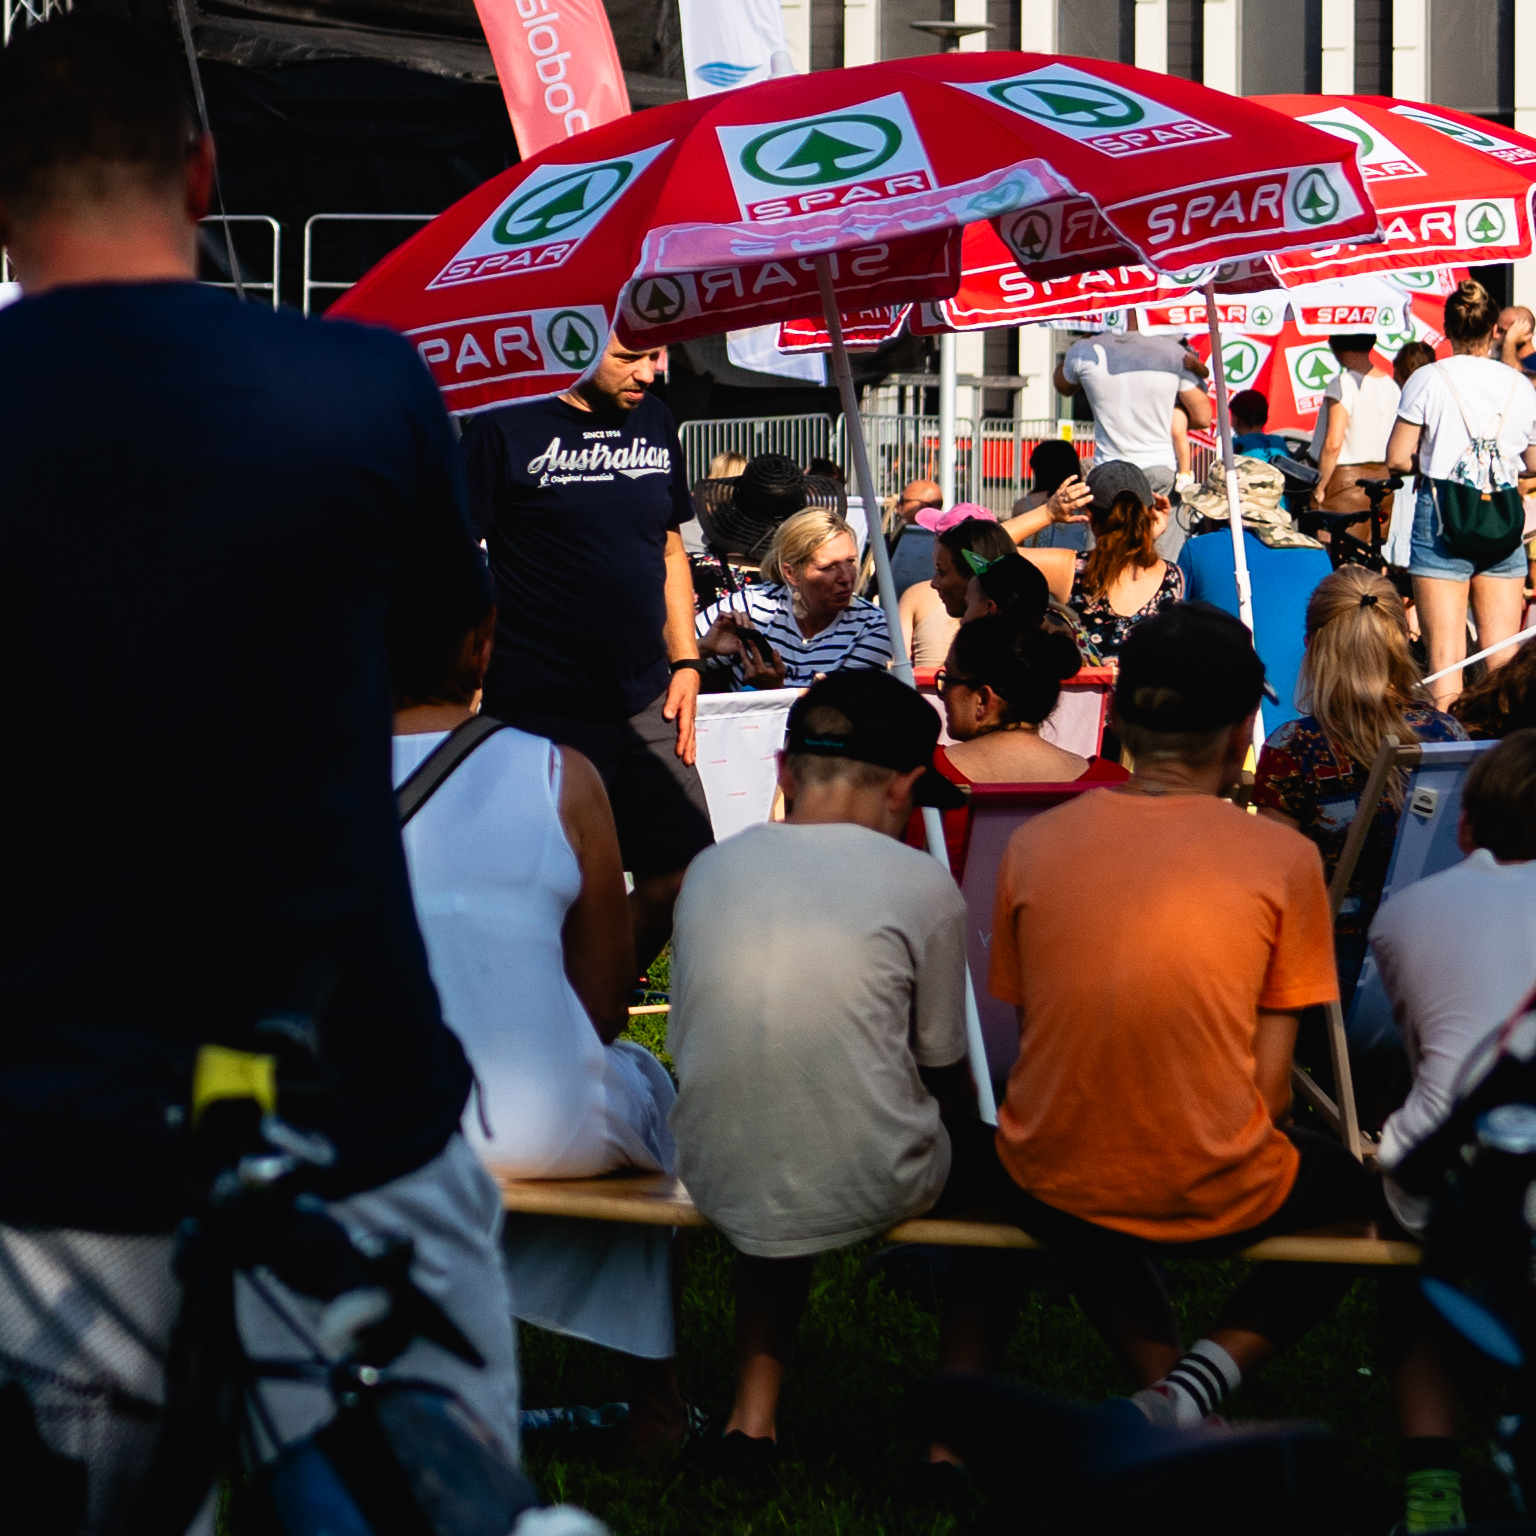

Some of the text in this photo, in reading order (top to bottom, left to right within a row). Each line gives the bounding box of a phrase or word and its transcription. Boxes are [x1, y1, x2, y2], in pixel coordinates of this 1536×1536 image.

[1090, 122, 1217, 153] SPAR
[1364, 161, 1414, 177] AR
[752, 173, 926, 221] SPAR
[1147, 182, 1284, 246] SPAR
[441, 243, 570, 282] SPAR
[1316, 307, 1378, 324] SPAR
[417, 325, 538, 375] PAR
[528, 437, 671, 474] Australian
